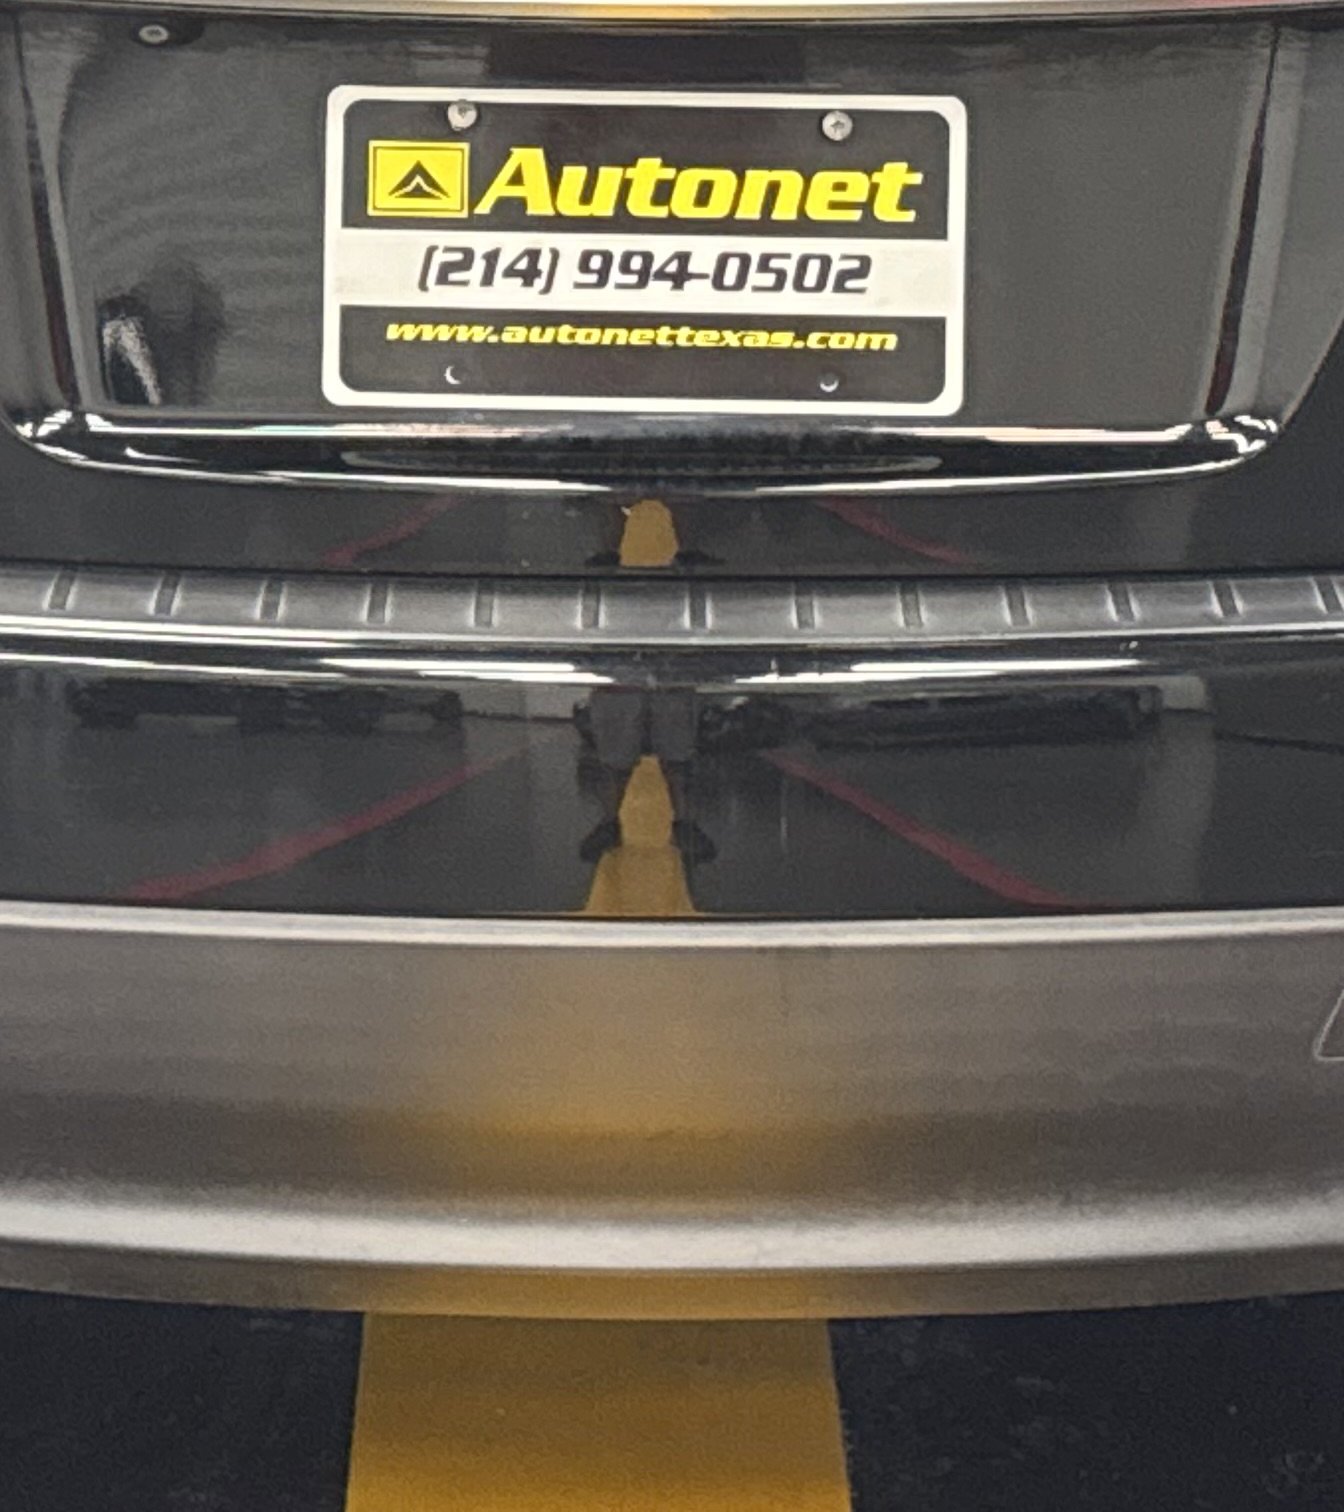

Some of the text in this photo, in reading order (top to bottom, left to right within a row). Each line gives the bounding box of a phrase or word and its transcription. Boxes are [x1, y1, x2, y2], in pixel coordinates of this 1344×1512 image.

[473, 146, 923, 223] Autonet
[417, 244, 873, 294] (214) 994-0502
[385, 322, 899, 351] www.autonettexas.com
